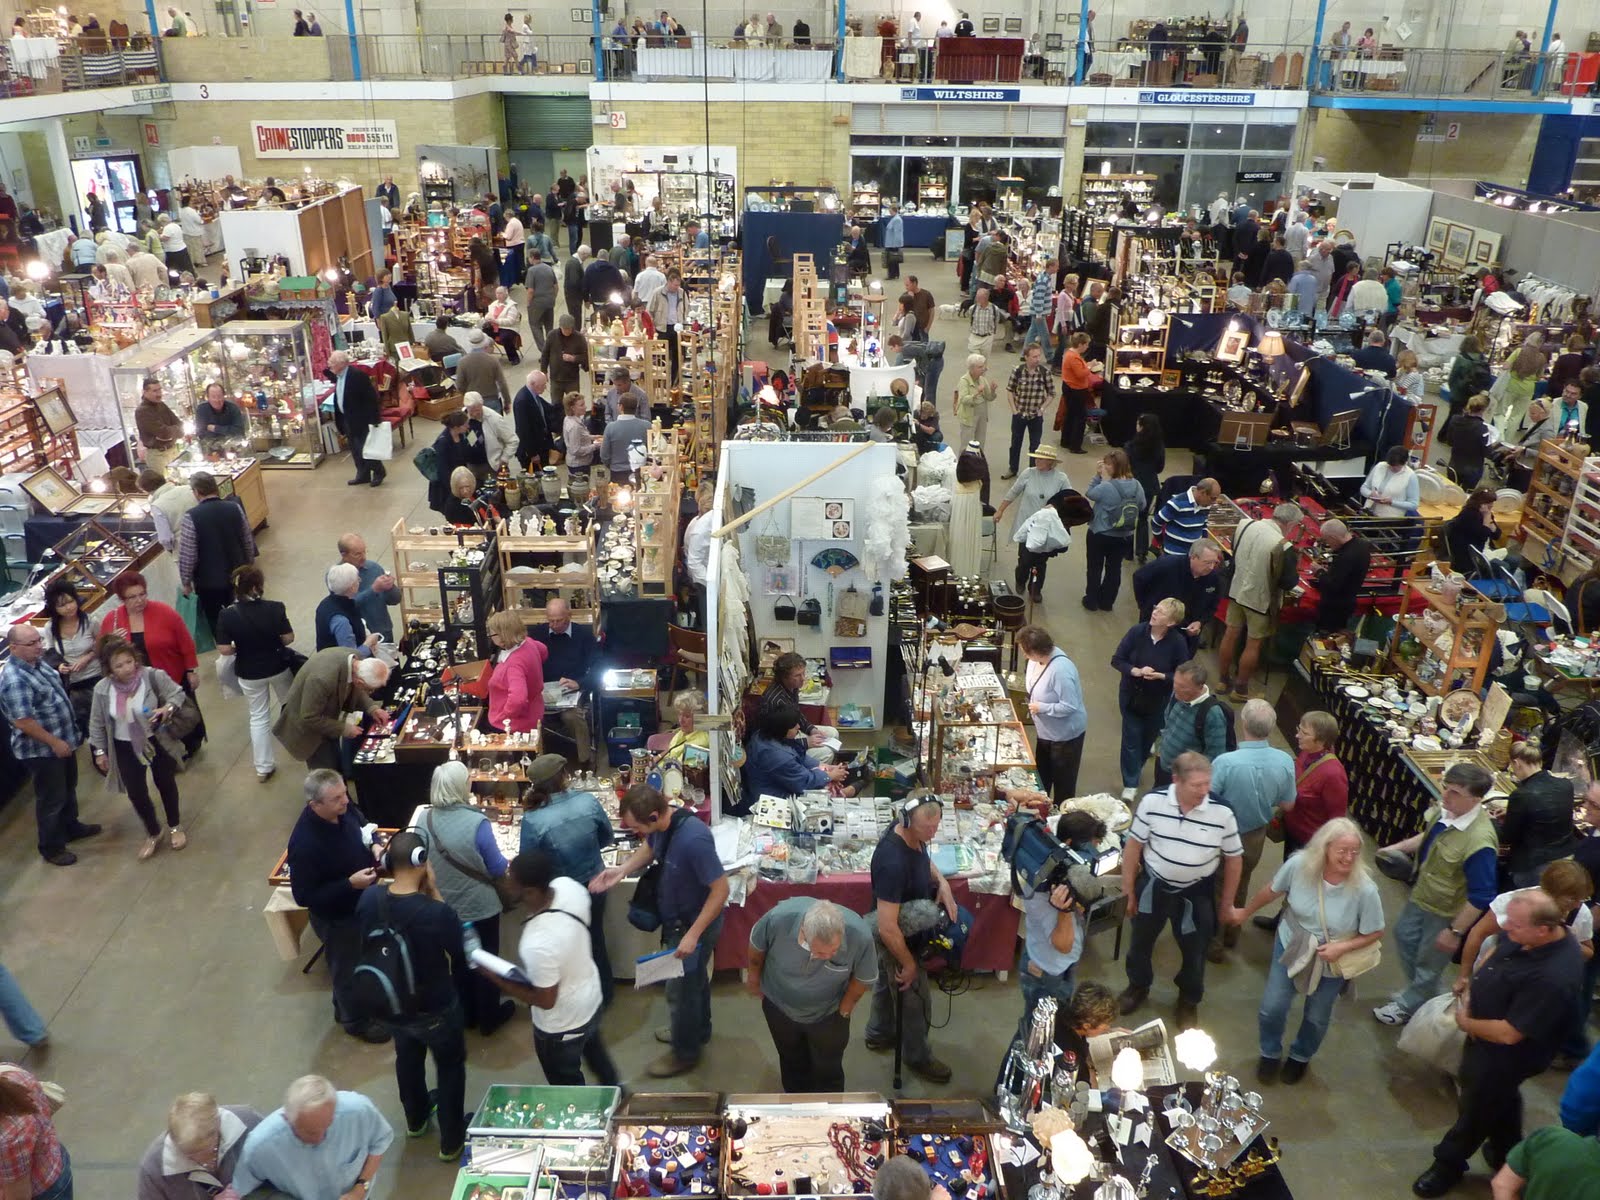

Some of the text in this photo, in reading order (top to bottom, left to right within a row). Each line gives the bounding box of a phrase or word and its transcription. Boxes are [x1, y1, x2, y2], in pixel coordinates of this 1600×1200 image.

[199, 84, 210, 99] 3
[933, 90, 1004, 100] WILTSHIRE
[1157, 93, 1251, 104] GLOUCESTERSHIRE
[610, 113, 625, 128] 3A
[366, 133, 381, 143] 555
[381, 133, 393, 143] 111
[1448, 124, 1458, 138] 2
[256, 125, 345, 152] CRIMESTOPPERS
